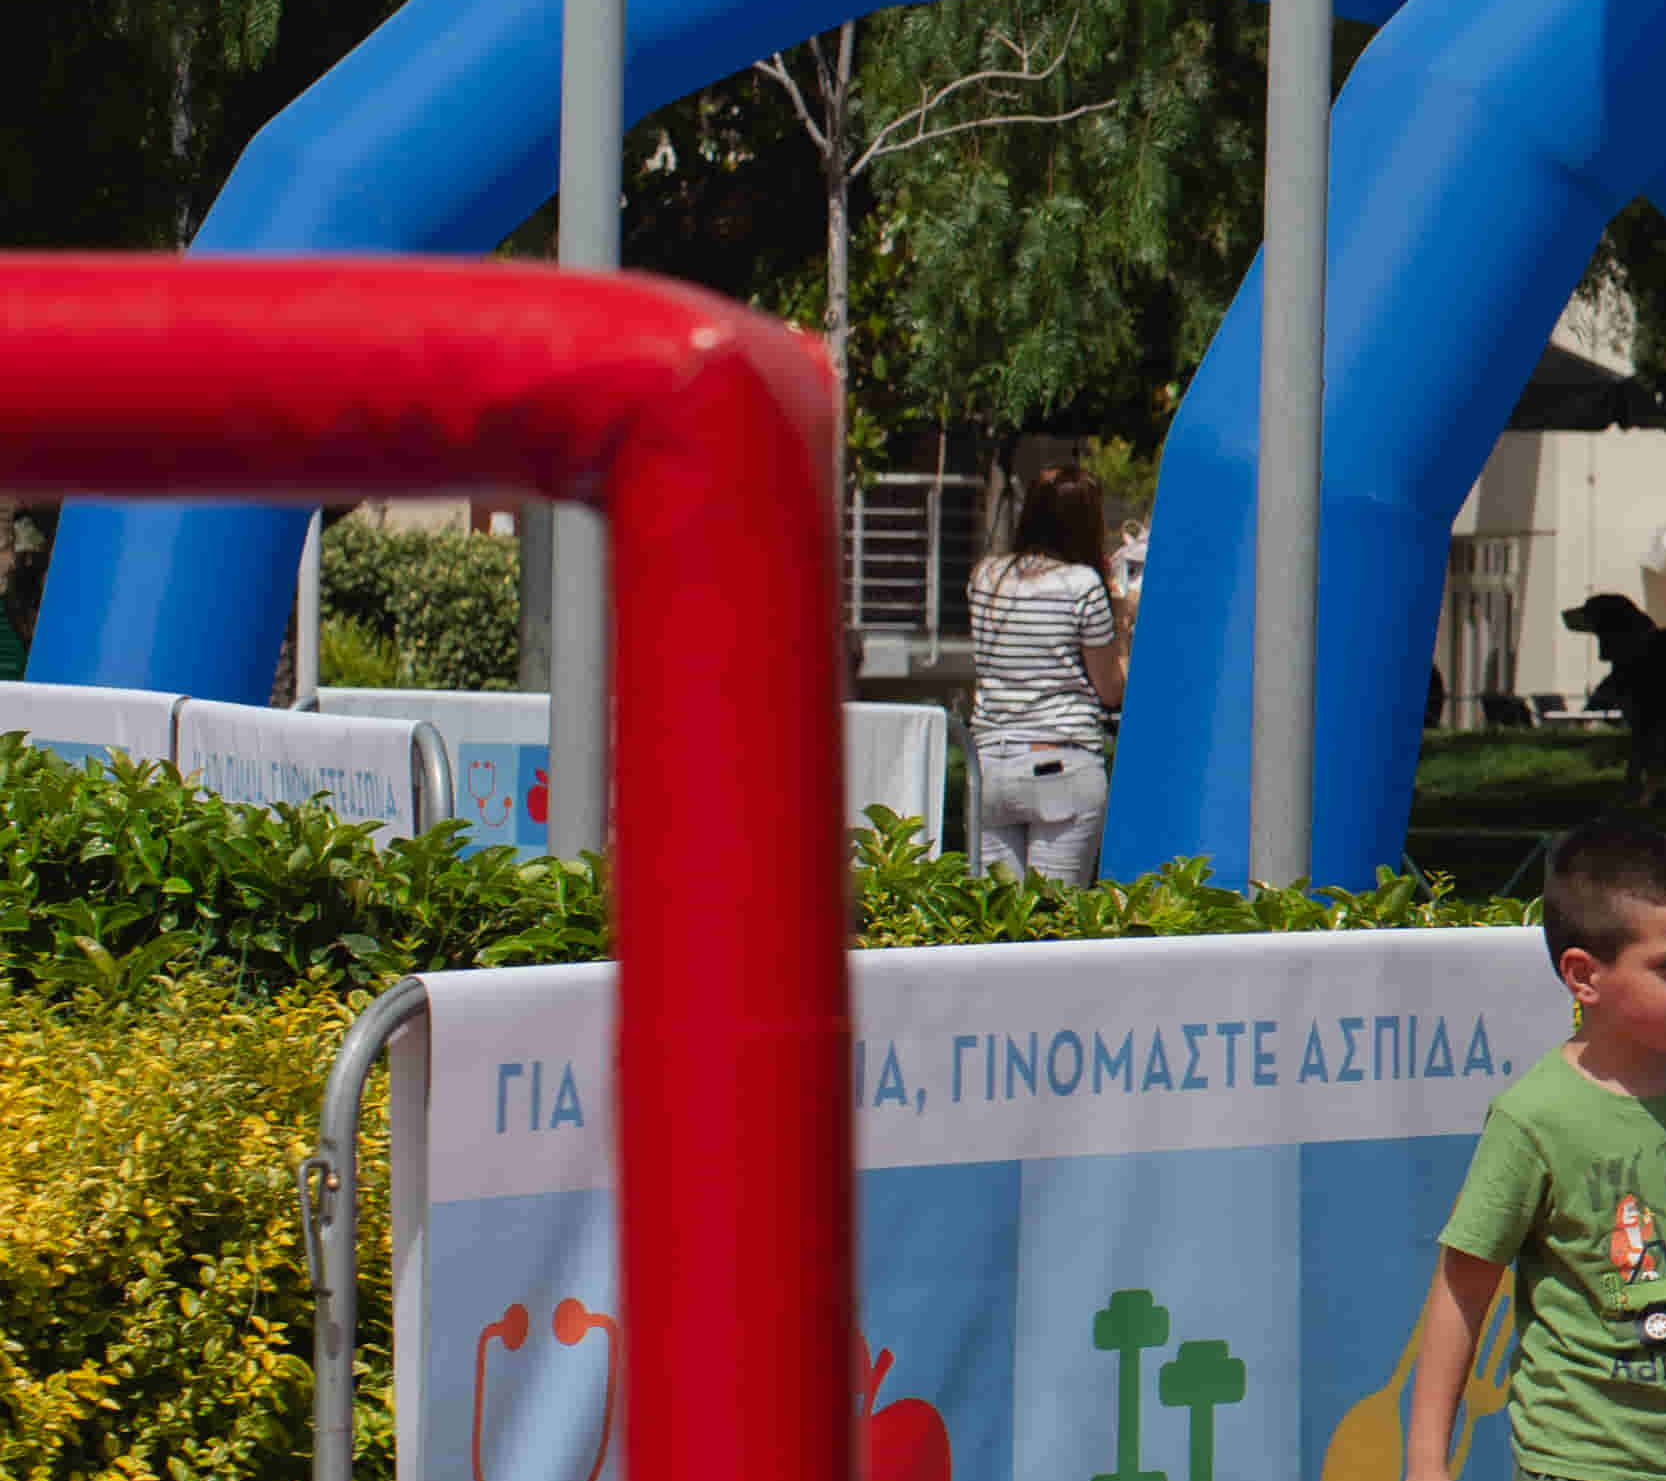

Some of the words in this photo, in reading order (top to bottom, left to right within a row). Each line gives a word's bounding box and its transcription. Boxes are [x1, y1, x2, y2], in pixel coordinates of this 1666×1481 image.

[496, 1059, 585, 1134] ΓΙΑ
[951, 1019, 1279, 1103] ΓΙΝΟΜΑΣΤΕ
[1295, 1012, 1513, 1084] ΑΣΠΙΔΑ.
